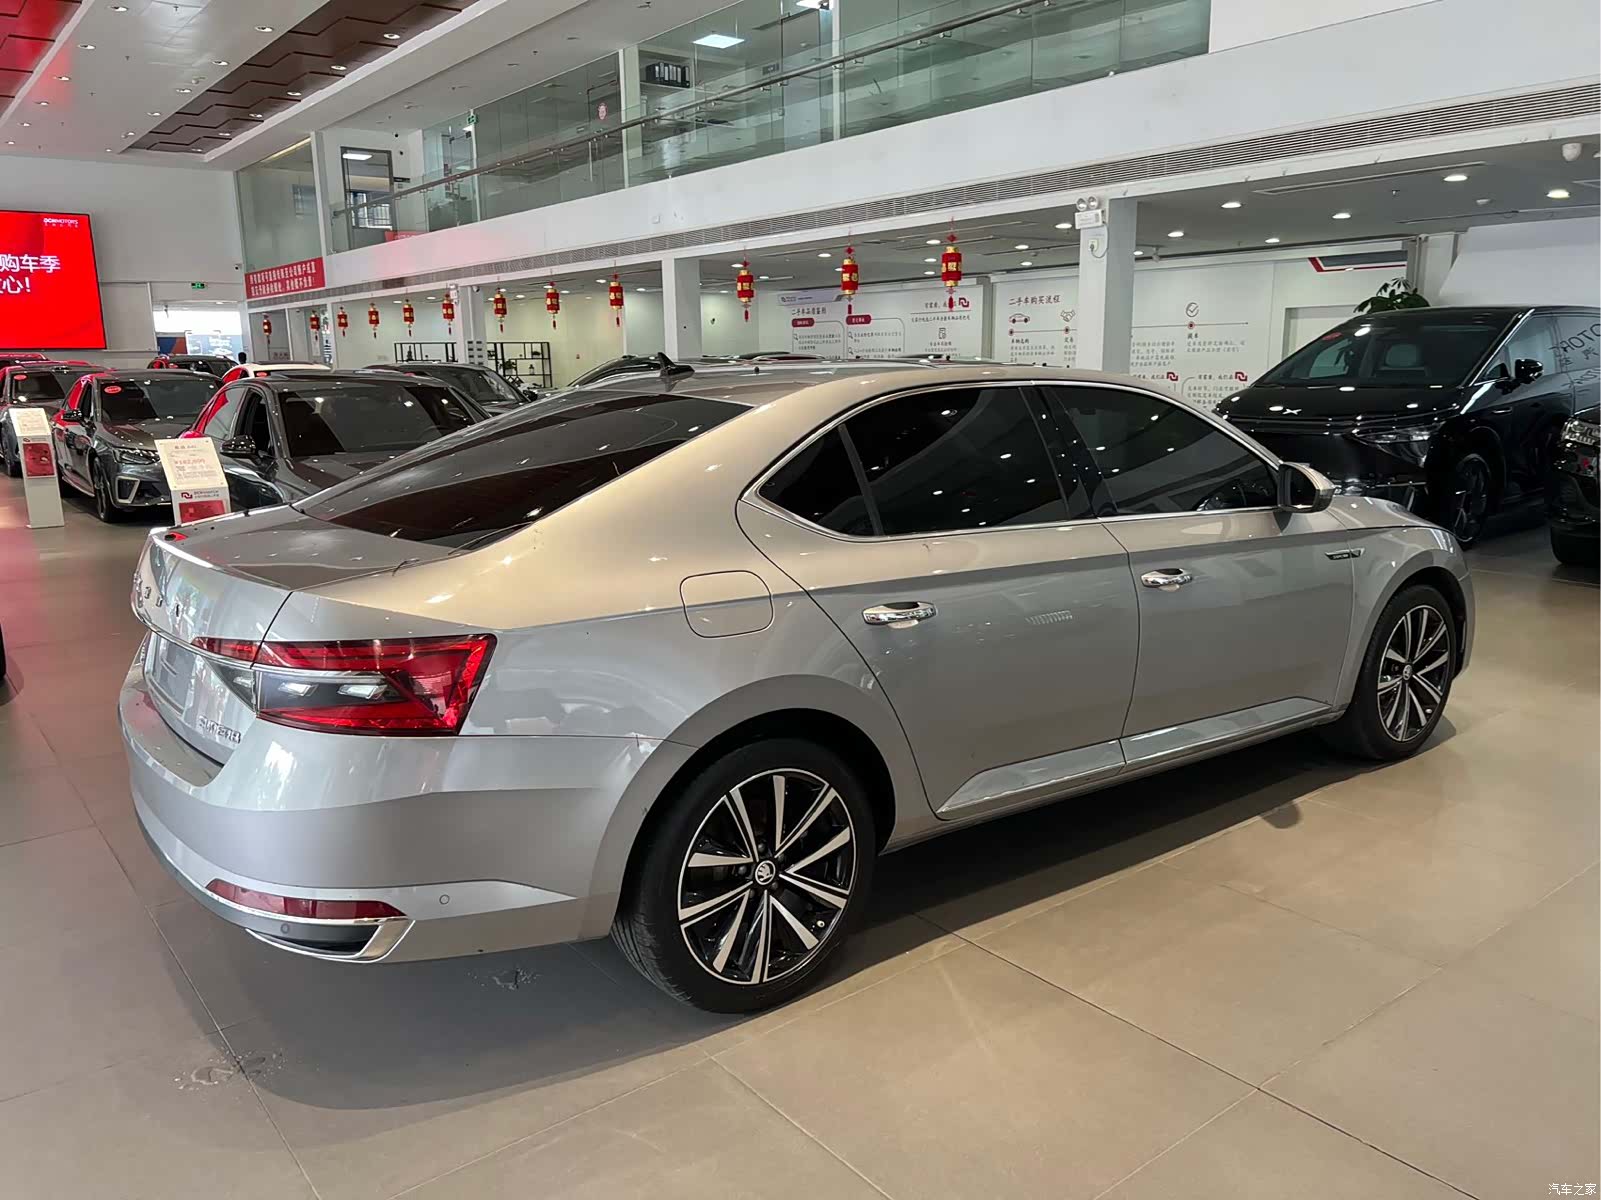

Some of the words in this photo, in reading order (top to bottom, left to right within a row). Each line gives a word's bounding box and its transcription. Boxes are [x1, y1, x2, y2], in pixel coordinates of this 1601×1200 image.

[0, 254, 61, 273] 购车季
[0, 275, 31, 294] 心!
